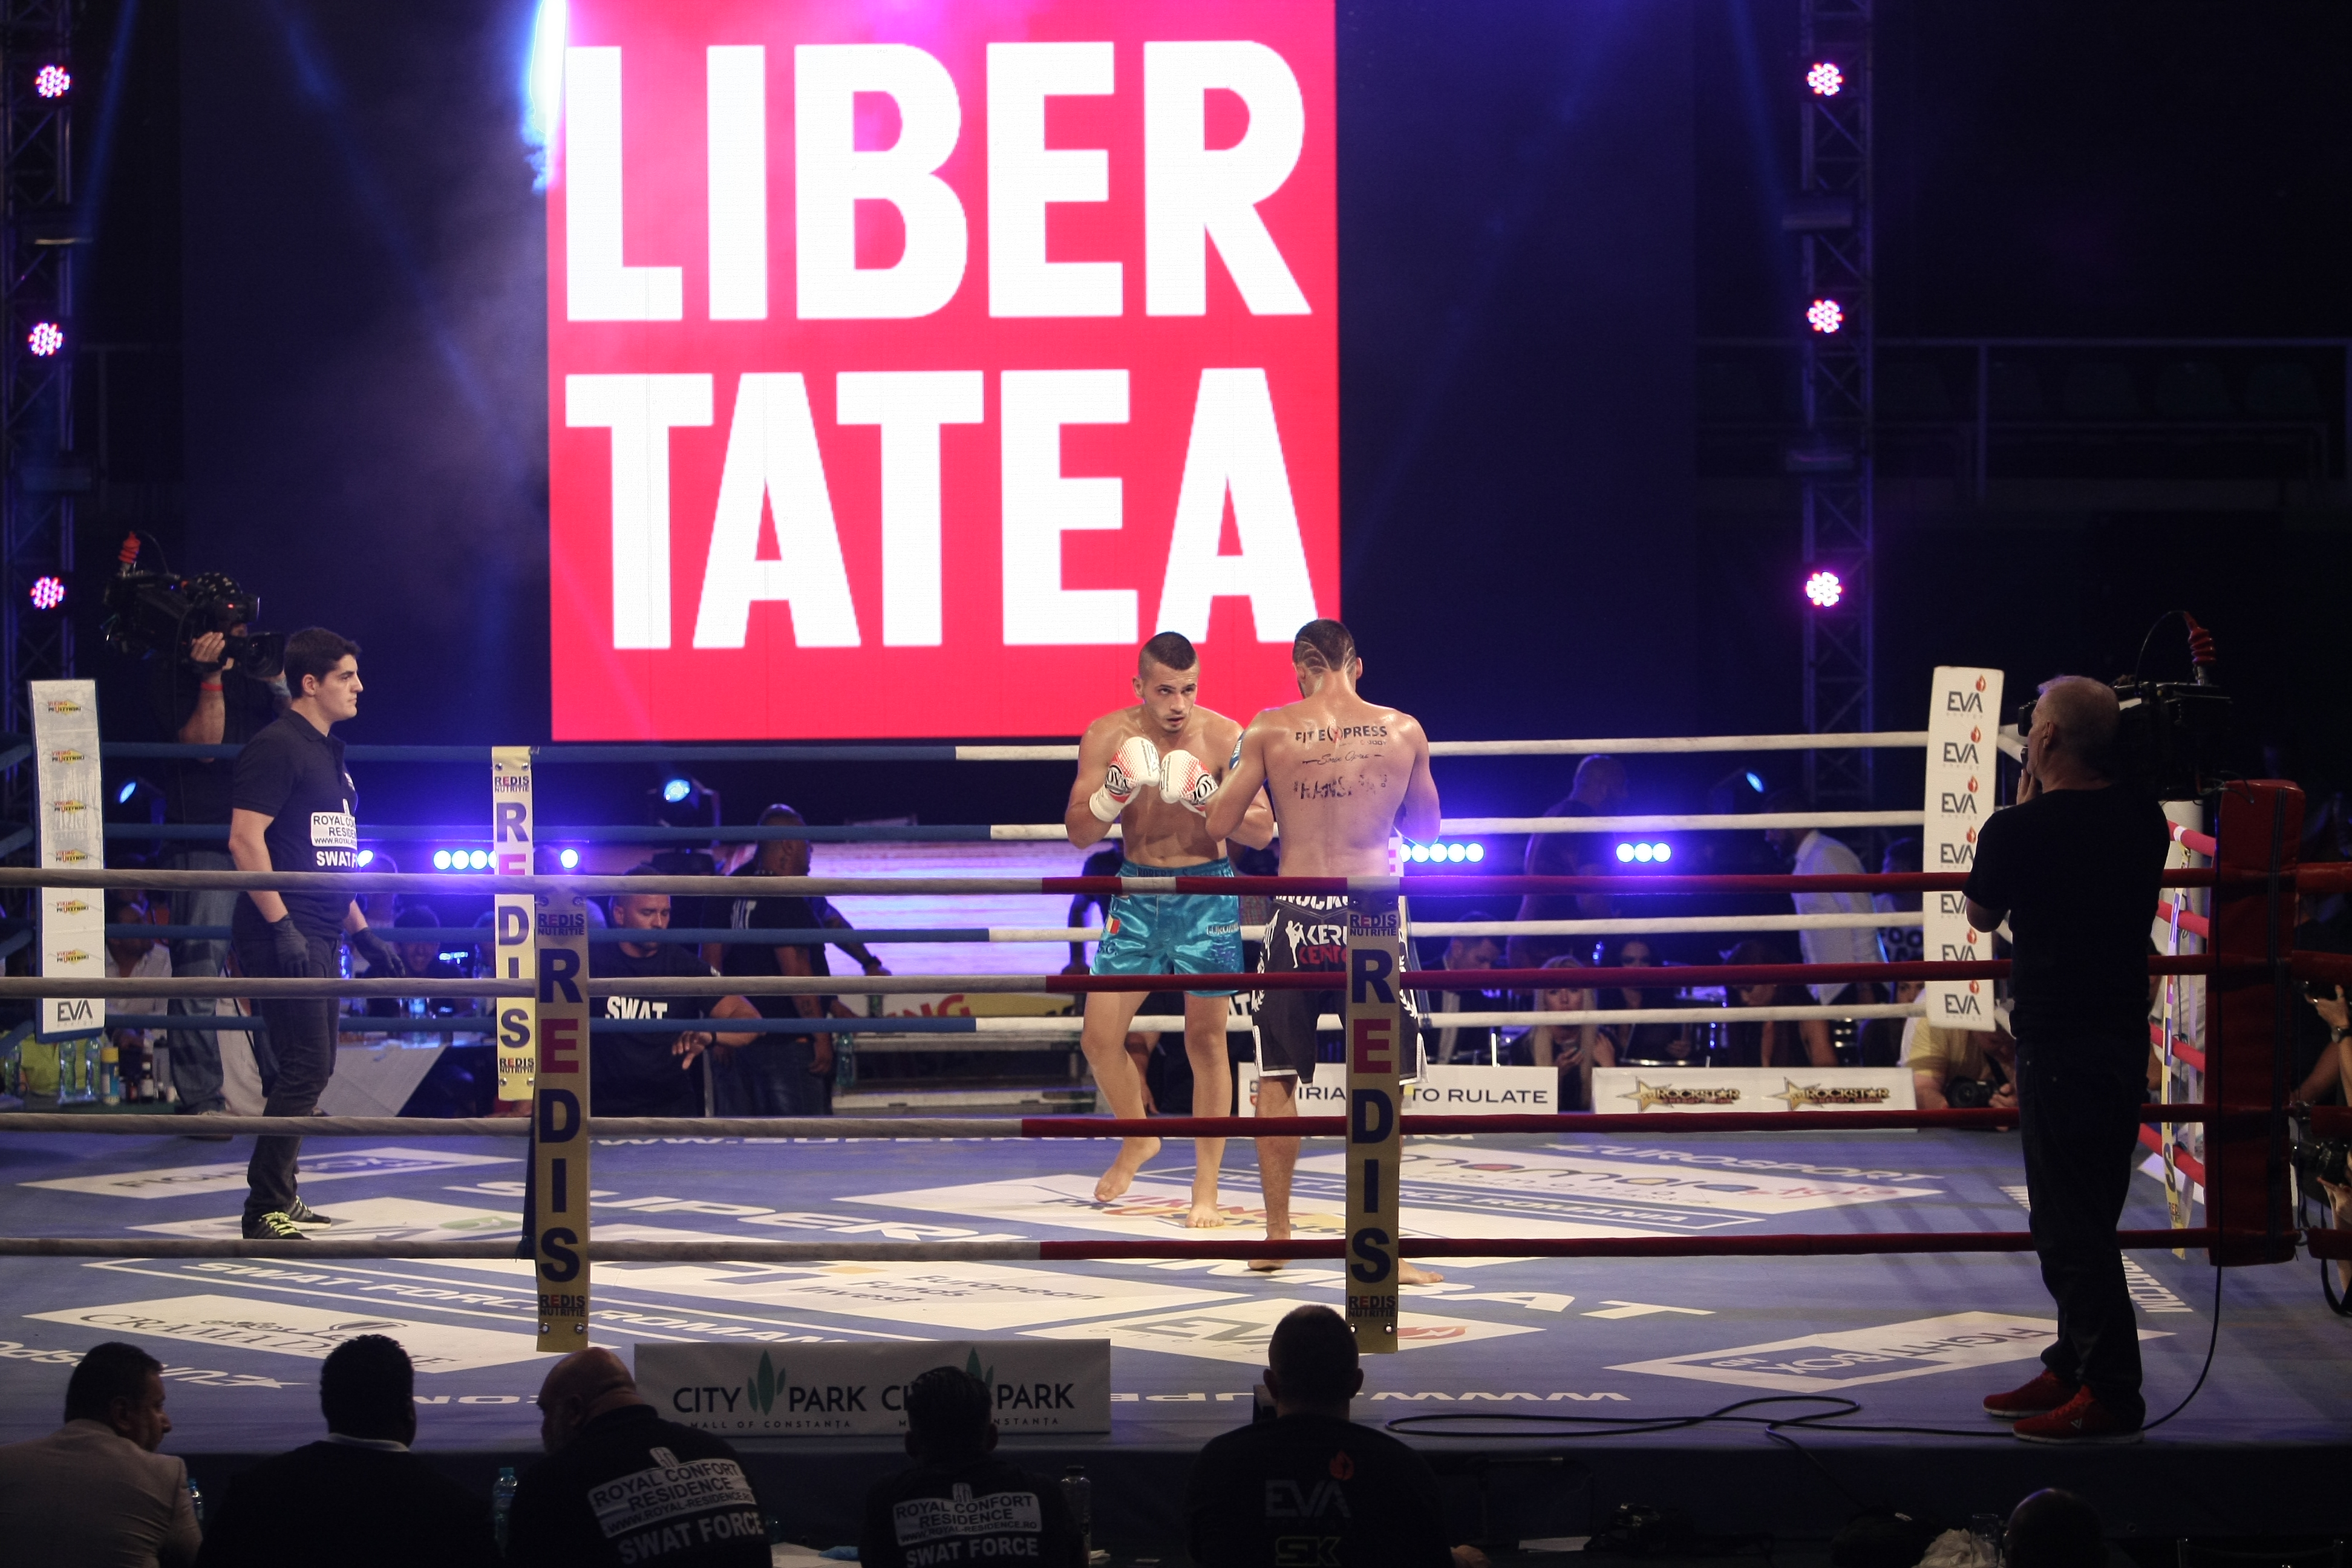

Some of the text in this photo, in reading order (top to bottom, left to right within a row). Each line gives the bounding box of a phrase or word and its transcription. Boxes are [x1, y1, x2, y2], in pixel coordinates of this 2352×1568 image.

[565, 41, 1313, 321] LIBER
[565, 368, 1319, 649] TATEA
[1948, 691, 1983, 713] EVA
[1943, 742, 1979, 764] EVA
[494, 776, 529, 786] REDIS
[1942, 792, 1977, 814] EVA
[313, 815, 345, 826] ROYAL
[316, 851, 351, 867] SWAT
[538, 913, 585, 926] REDIS
[1350, 914, 1397, 927] REDIS
[538, 927, 585, 936] NUTRITIE
[1350, 927, 1397, 936] NUTRITIE
[57, 1000, 93, 1022] EVA
[1945, 994, 1981, 1015] EVA
[499, 1058, 534, 1067] REDIS
[1448, 1089, 1549, 1103] RULATE
[539, 949, 584, 1282] REDIS
[1350, 949, 1396, 1283] REDIS
[181, 1263, 374, 1285] SWAT
[358, 1283, 538, 1311] FORC
[787, 1285, 925, 1302] Invest
[846, 1280, 975, 1298] Funds
[904, 1275, 1105, 1300] European
[540, 1295, 586, 1307] REDIS
[1348, 1296, 1396, 1308] REDIS
[540, 1308, 586, 1317] NUTRITIE
[673, 1383, 1075, 1413] CITY PARK CI PARK
[593, 1462, 740, 1508] ROYAL CONFORT
[627, 1477, 734, 1511] RESIDENCE
[895, 1495, 1033, 1520] ROYAL CONFORT
[1265, 1480, 1352, 1518] EVA
[920, 1508, 1014, 1529] RESIDENCE
[618, 1512, 765, 1566] SWAT FORCE
[906, 1537, 1039, 1568] SWAT FORCE
